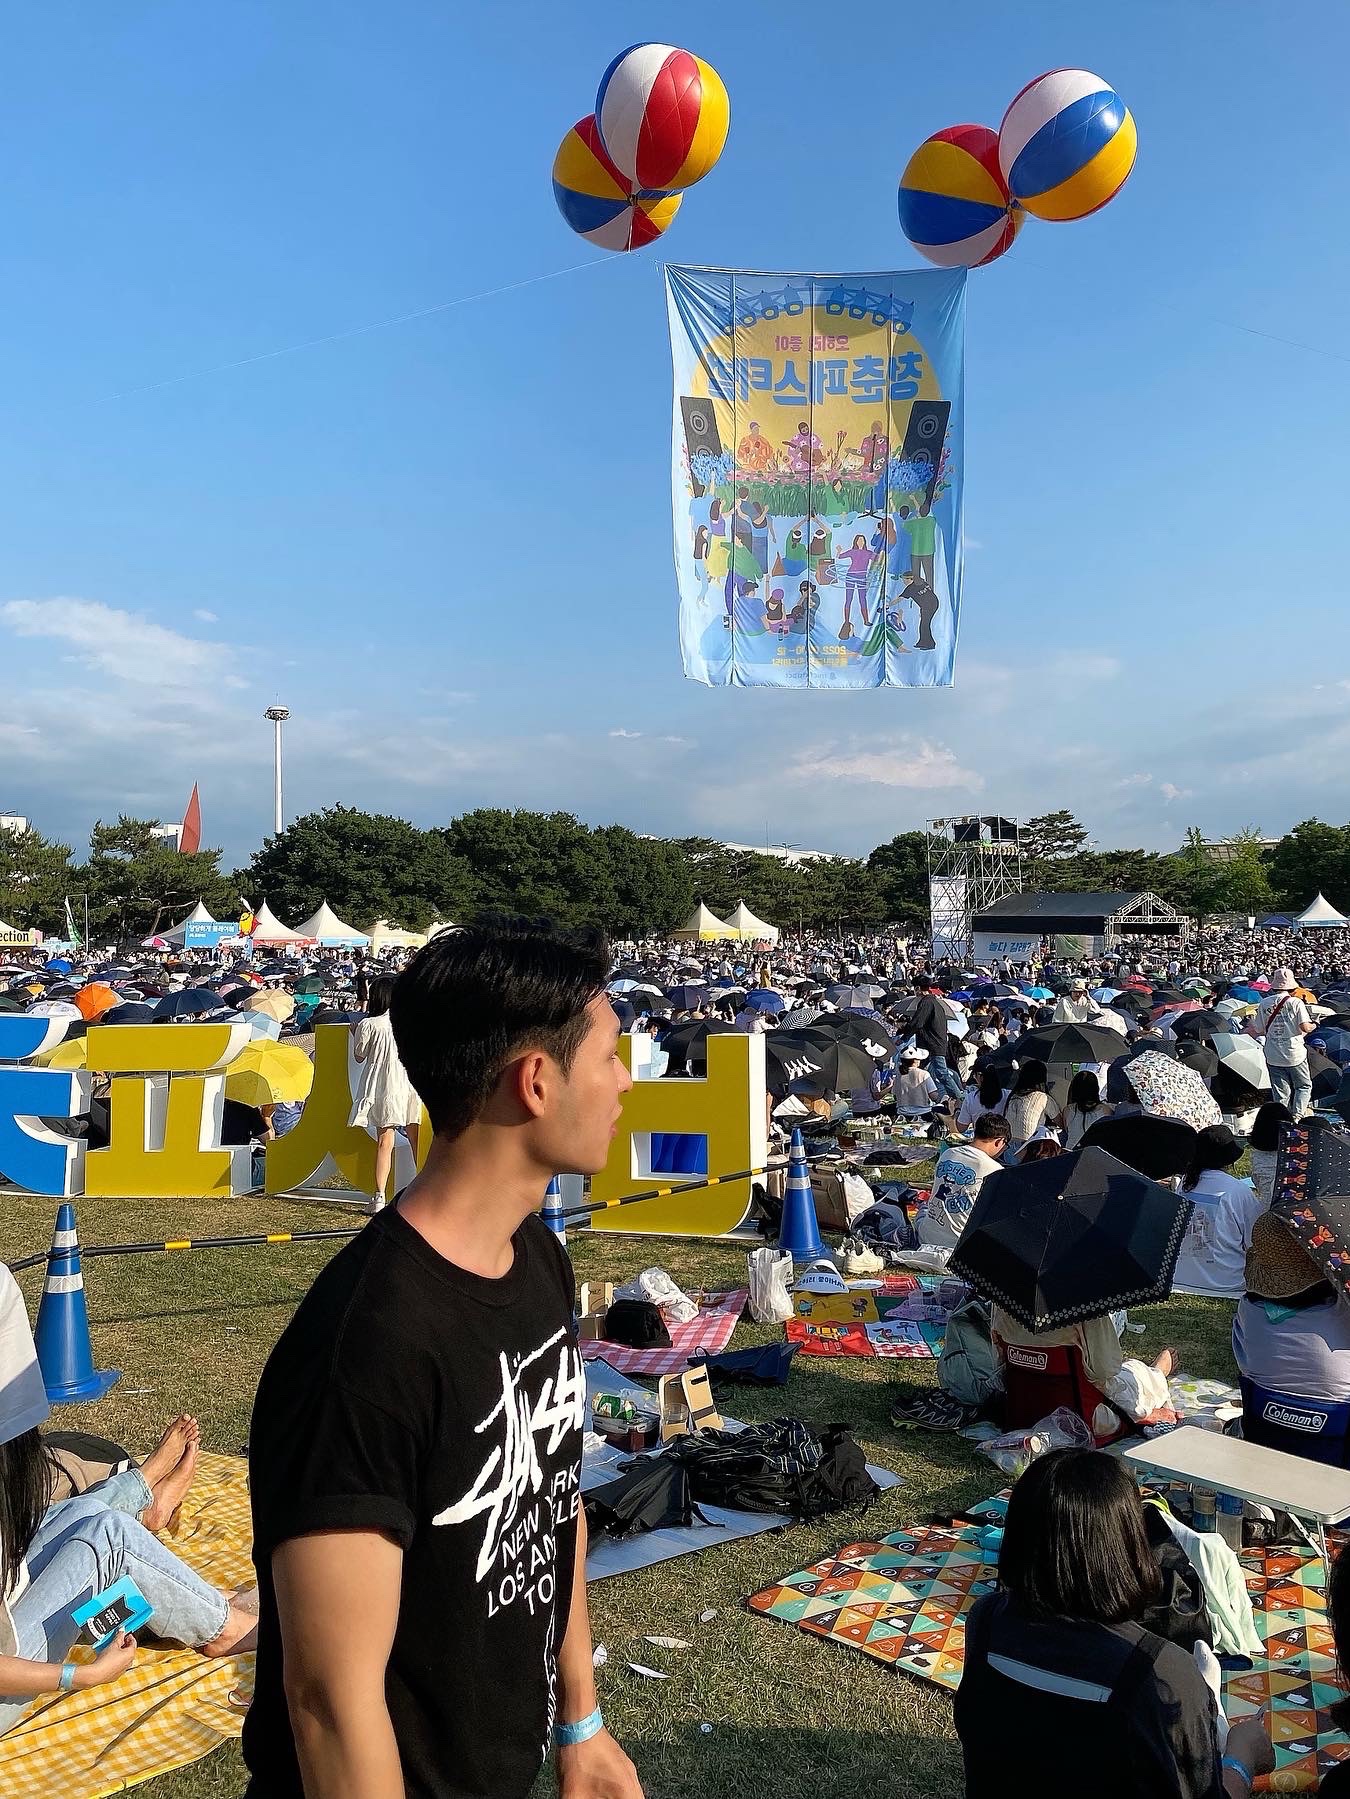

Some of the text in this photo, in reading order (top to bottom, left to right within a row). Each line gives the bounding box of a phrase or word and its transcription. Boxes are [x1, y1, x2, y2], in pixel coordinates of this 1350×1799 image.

[1009, 1349, 1038, 1364] Coleman
[1268, 1405, 1312, 1426] Coleman
[502, 1503, 539, 1568] NEW
[487, 1562, 525, 1618] LOS
